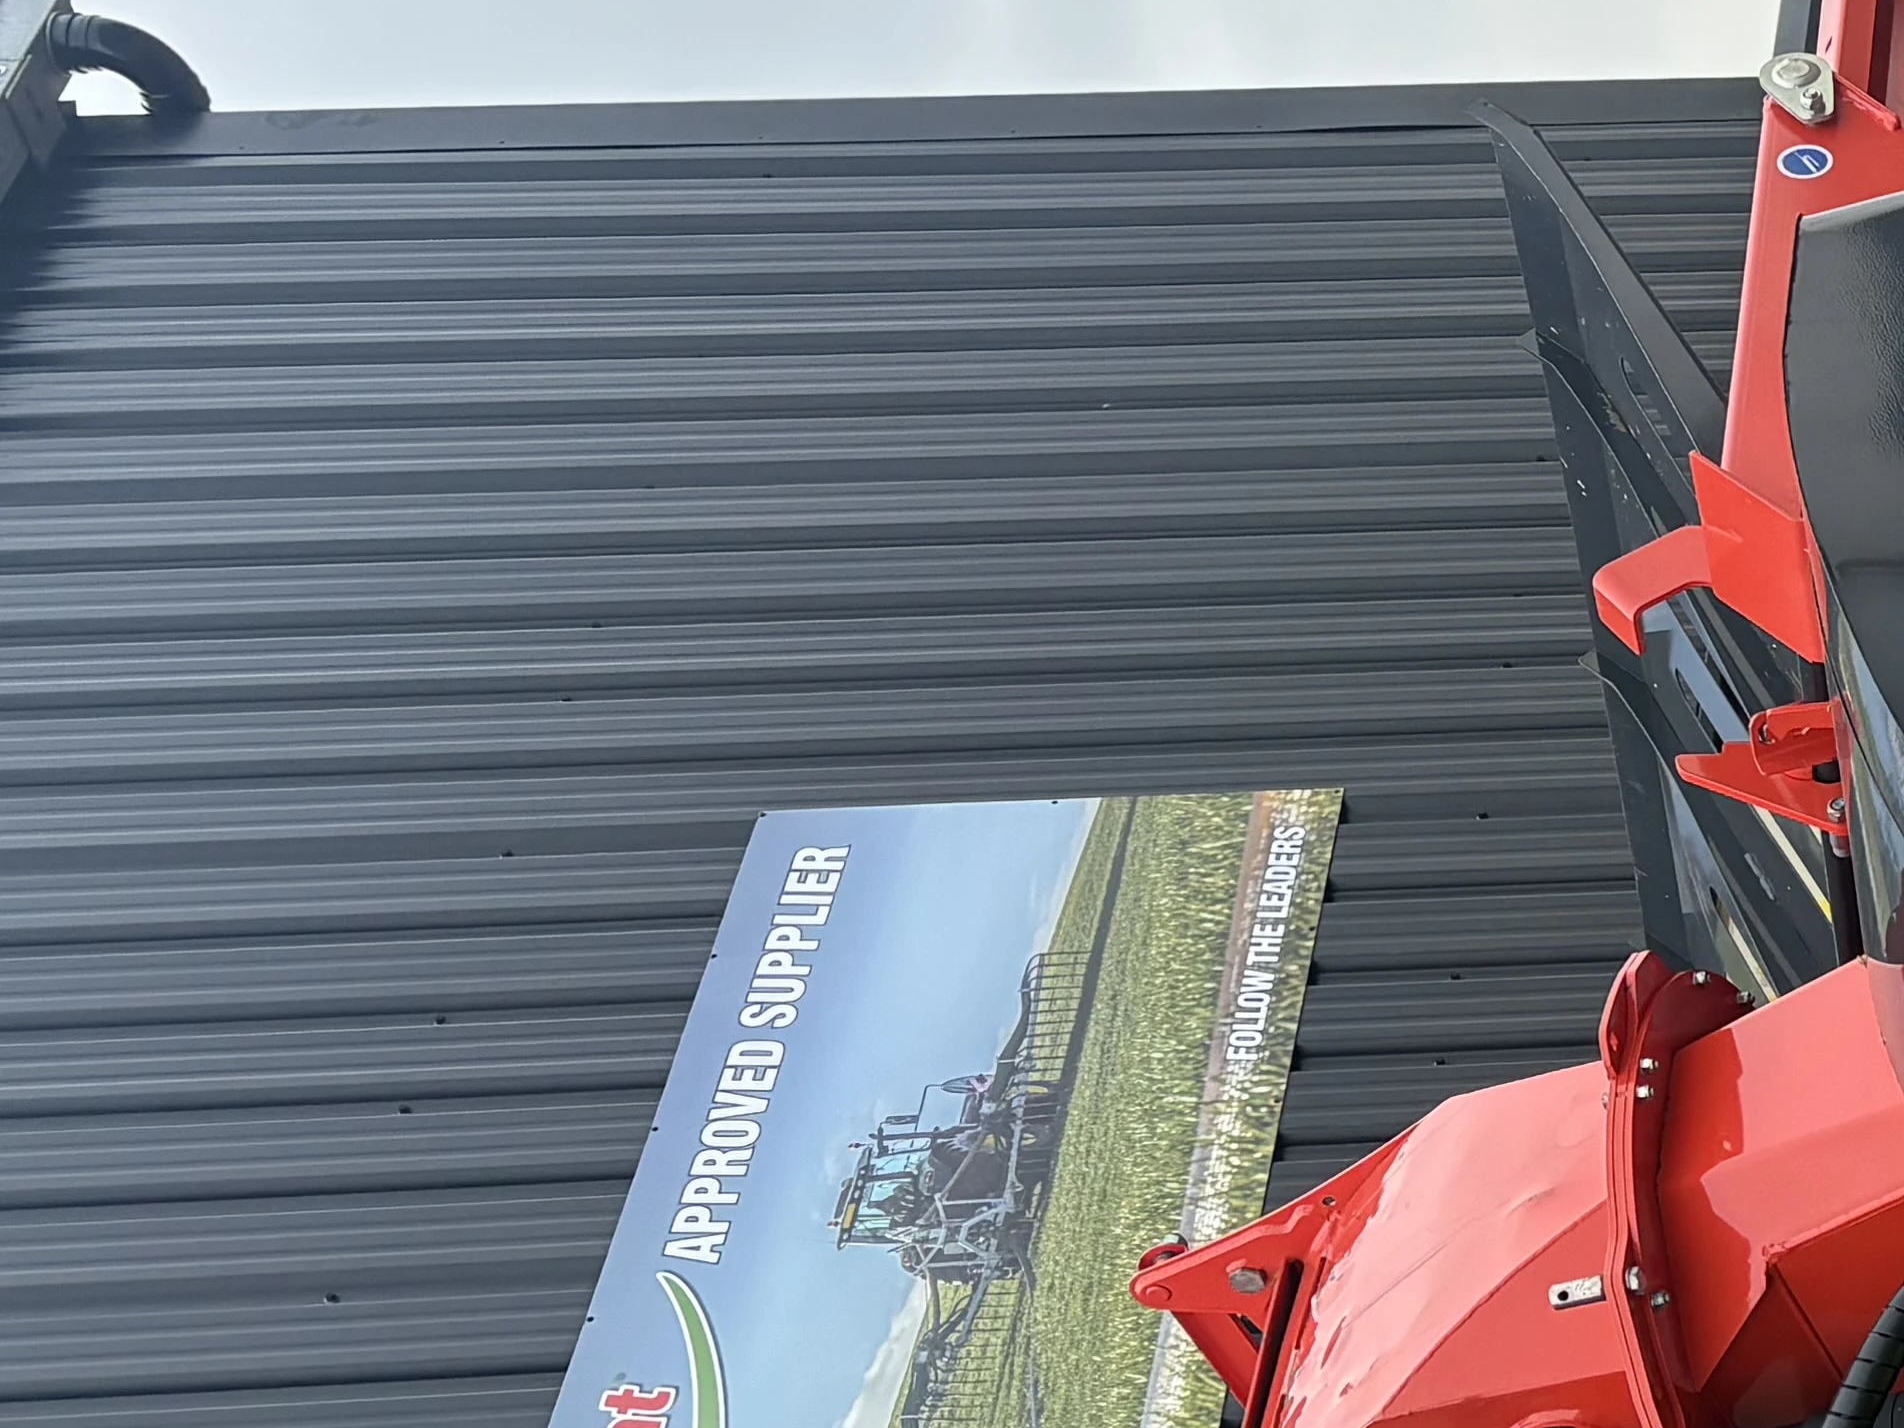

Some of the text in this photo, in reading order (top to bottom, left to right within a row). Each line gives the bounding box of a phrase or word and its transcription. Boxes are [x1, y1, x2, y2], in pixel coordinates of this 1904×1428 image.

[662, 845, 851, 1265] APPROVED SUPPLIER
[1226, 825, 1306, 1061] FOLLOW THE LEADERS
